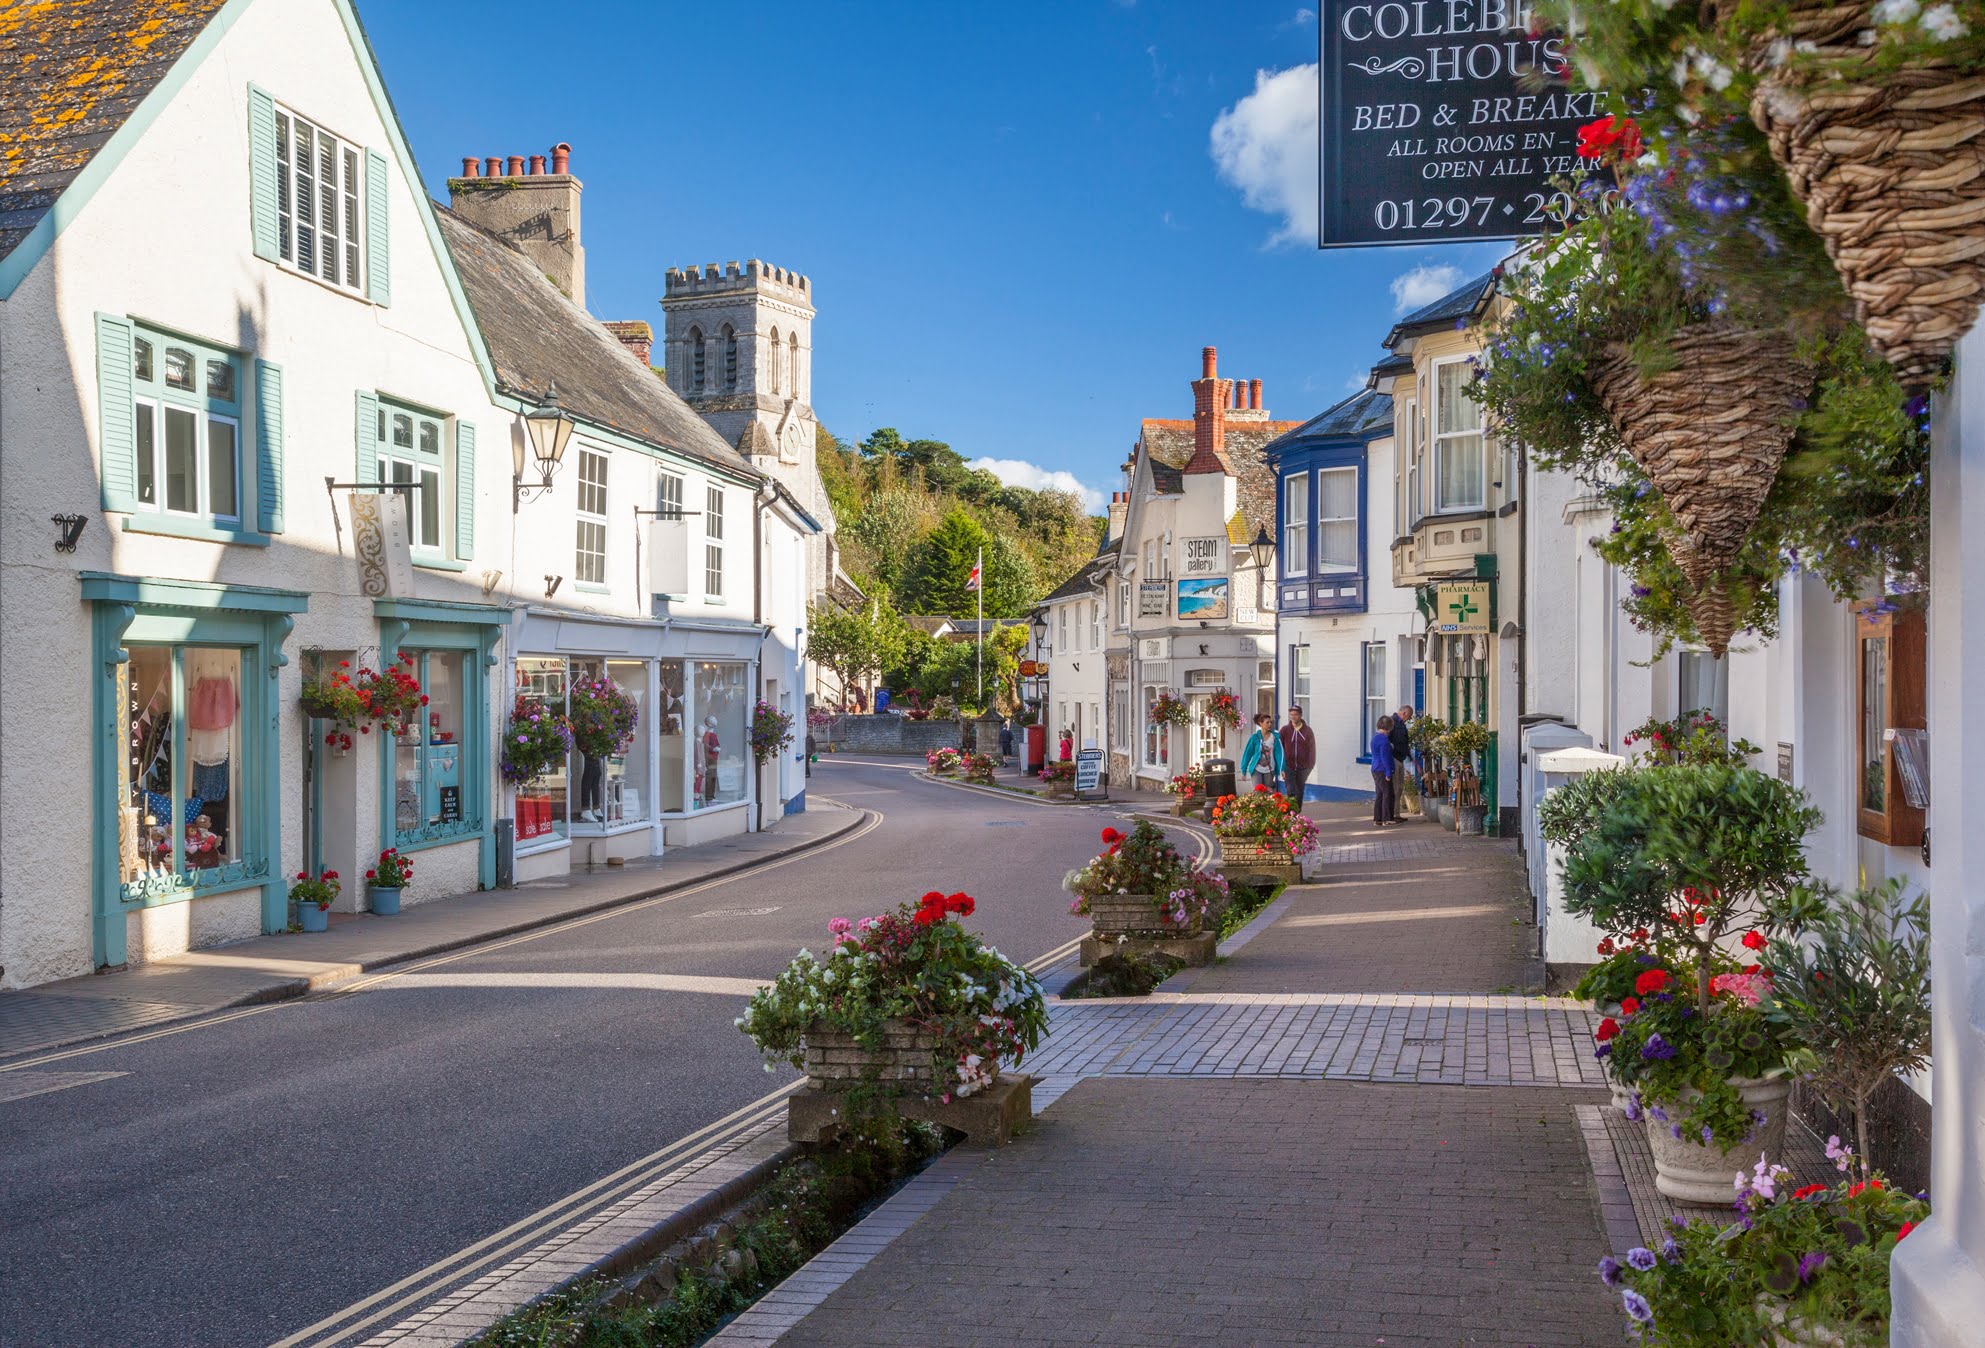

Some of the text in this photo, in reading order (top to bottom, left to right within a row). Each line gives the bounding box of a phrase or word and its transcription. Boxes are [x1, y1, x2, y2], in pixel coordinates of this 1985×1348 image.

[1426, 38, 1594, 83] HOUS
[1352, 103, 1421, 131] BED
[1433, 103, 1458, 127] &
[1387, 138, 1428, 157] ALL
[1435, 133, 1515, 155] ROOMS
[1422, 155, 1603, 180] OPEN ALL YEAR
[1374, 196, 1496, 230] 01297
[389, 495, 401, 548] BROWN
[1187, 539, 1217, 558] STEAM
[1187, 559, 1213, 572] gallery
[1440, 585, 1488, 593] PHARMACY
[131, 681, 139, 765] BROWN
[525, 820, 537, 835] sale
[539, 816, 551, 832] sale
